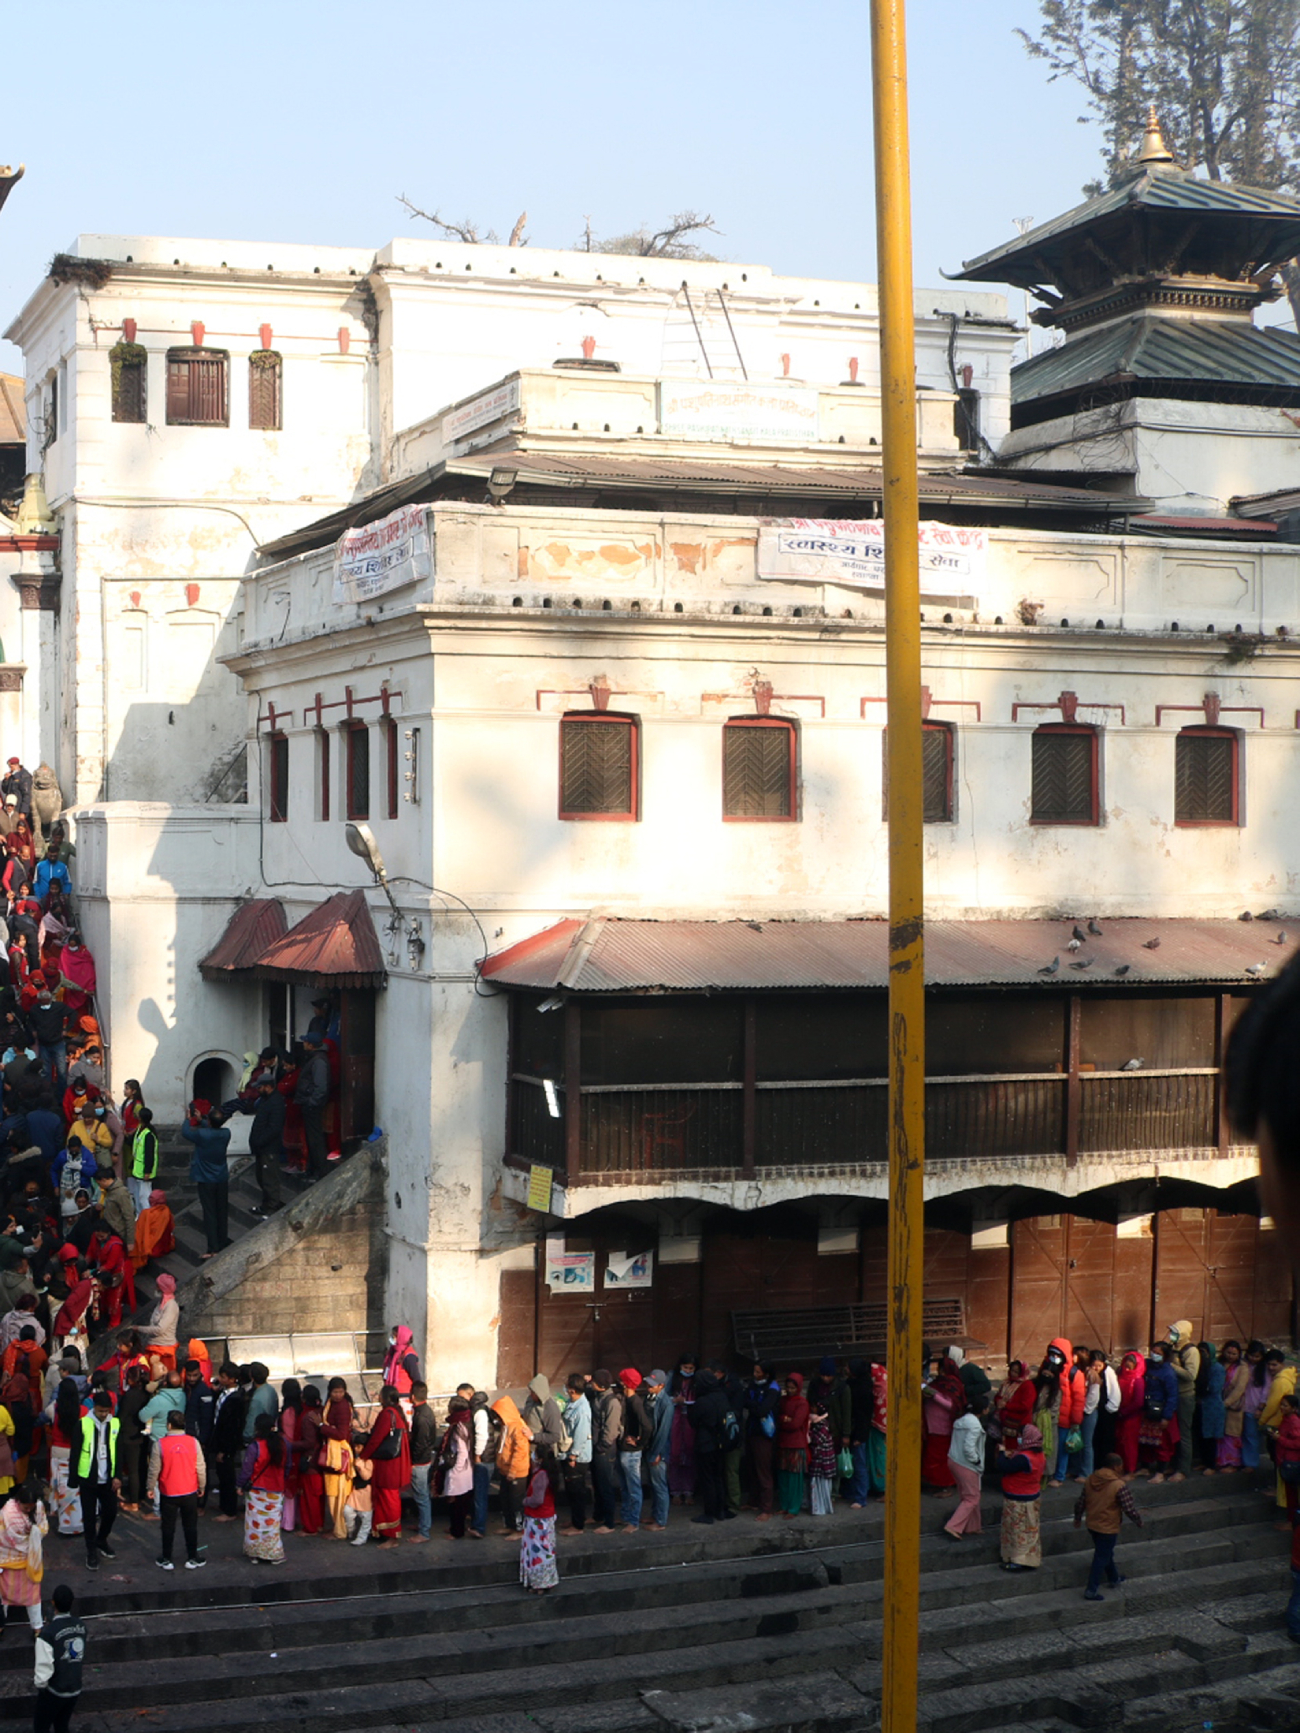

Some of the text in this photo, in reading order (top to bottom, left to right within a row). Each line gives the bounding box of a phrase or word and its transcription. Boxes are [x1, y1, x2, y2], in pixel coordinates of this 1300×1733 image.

[664, 422, 685, 432] SHREE
[783, 538, 856, 556] स्वास्थ्य
[930, 554, 960, 568] सेवा
